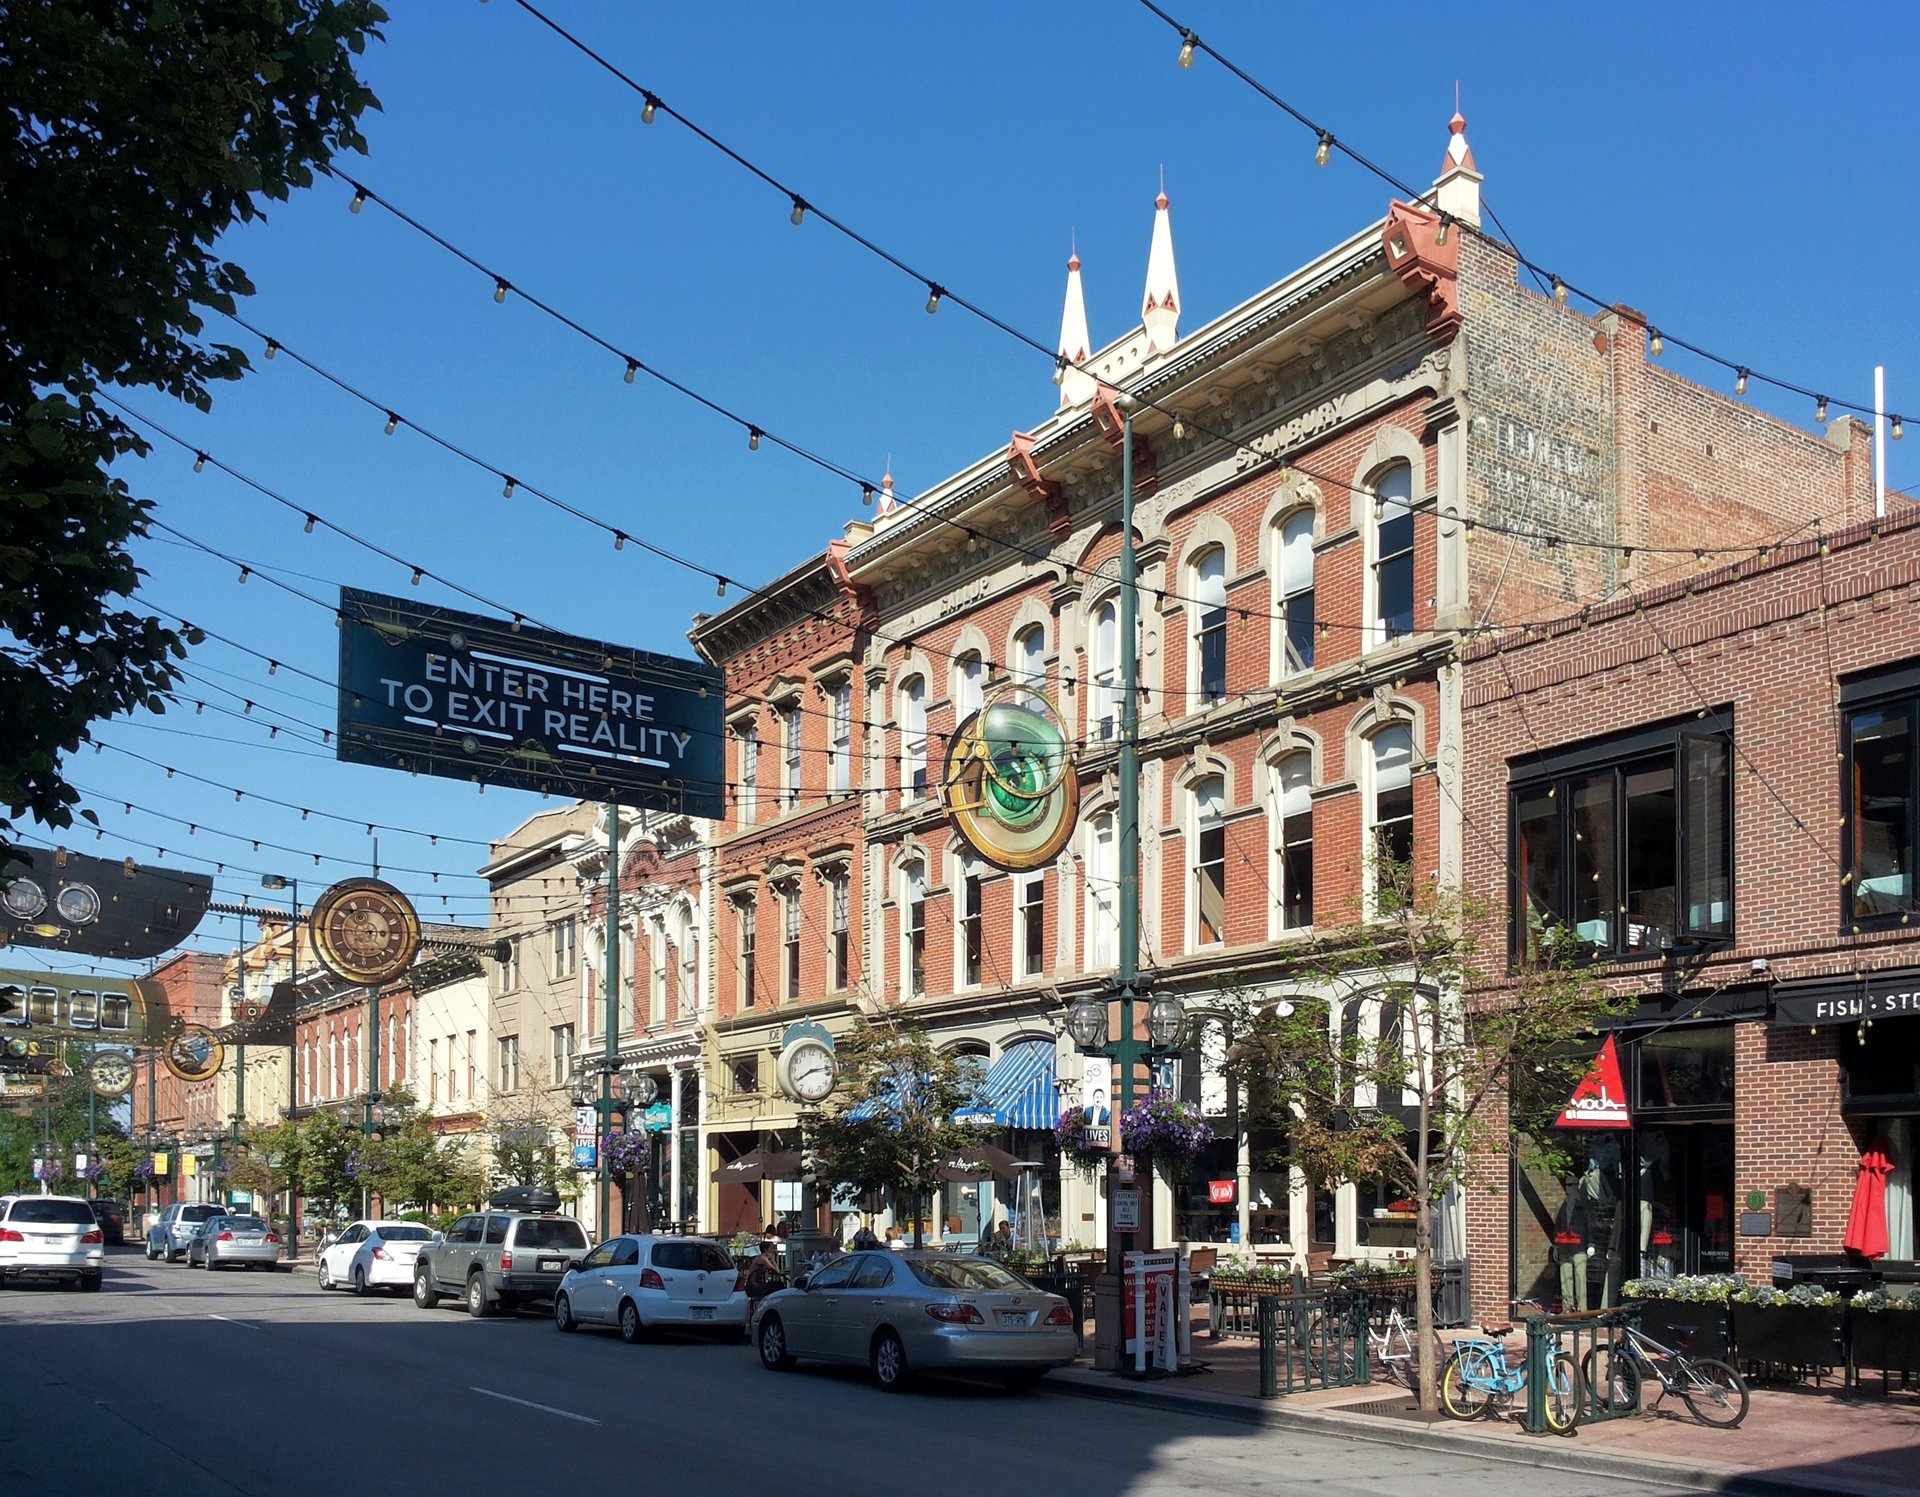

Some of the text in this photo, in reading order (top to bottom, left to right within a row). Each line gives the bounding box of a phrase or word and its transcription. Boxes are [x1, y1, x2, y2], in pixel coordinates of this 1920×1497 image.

[1236, 393, 1347, 470] STANBURY
[940, 575, 991, 616] GALLUP
[426, 652, 655, 721] ENTER HERE
[380, 678, 692, 759] TO EXIT REALITY
[1817, 999, 1863, 1018] FISH
[576, 1110, 597, 1126] 50
[576, 1125, 597, 1134] YEARS
[575, 1139, 596, 1148] LIVES
[1085, 1129, 1108, 1141] LIVES
[1158, 1286, 1166, 1357] VALET
